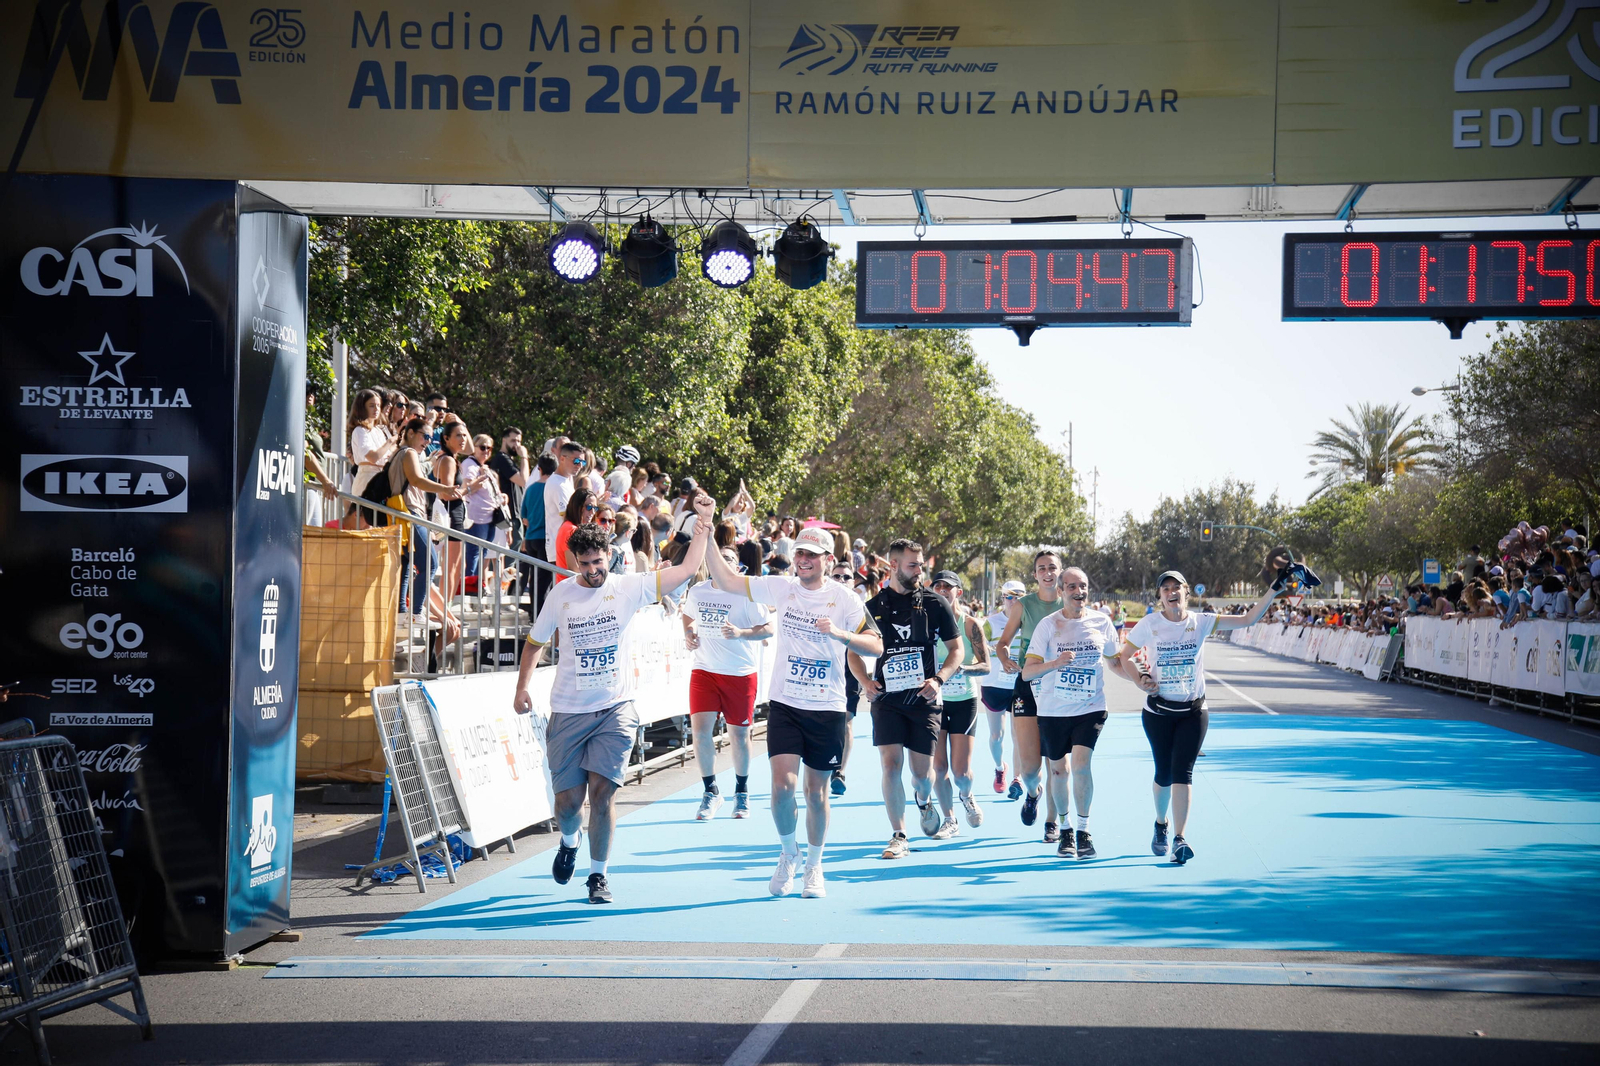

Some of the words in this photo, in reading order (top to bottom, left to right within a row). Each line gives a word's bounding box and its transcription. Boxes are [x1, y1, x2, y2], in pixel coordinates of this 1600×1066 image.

[250, 8, 306, 48] 25
[351, 10, 503, 51] Medio
[529, 14, 740, 54] Maratón
[878, 26, 960, 45] RFEA
[249, 50, 306, 64] EDICIÓN
[870, 47, 951, 61] SERIES
[862, 63, 914, 75] RUTA
[918, 62, 998, 75] RUNNING
[348, 60, 571, 113] Almería
[585, 64, 740, 115] 2024
[775, 86, 900, 115] RAMÓN
[917, 91, 996, 115] RUIZ
[1011, 82, 1180, 114] ANDÚJAR
[20, 246, 154, 297] CASI
[252, 316, 298, 346] COOPERACIÓN
[252, 335, 270, 354] 2005
[20, 386, 191, 408] ESTRELLA
[59, 408, 81, 419] DE
[83, 408, 153, 420] LEVANTE
[44, 471, 169, 495] IKEA
[71, 548, 136, 563] Barceló
[70, 565, 112, 580] Cabo
[117, 565, 137, 580] de
[70, 583, 109, 597] Gata
[697, 602, 732, 610] COSENTINO
[568, 621, 595, 630] Almería
[596, 615, 616, 625] 2024
[701, 613, 726, 624] 5242
[784, 611, 809, 624] Almería
[59, 613, 144, 659] ego
[113, 651, 131, 659] sport
[132, 651, 148, 659] center
[887, 646, 925, 654] CUPRA
[580, 652, 615, 668] 5795
[887, 659, 919, 674] 5388
[790, 663, 827, 679] 5796
[1161, 665, 1194, 678] 5050
[51, 679, 97, 694] SER
[1060, 672, 1092, 686] 5051
[128, 678, 155, 698] 40
[253, 680, 283, 706] ALMERÍA
[51, 715, 65, 725] La
[67, 715, 88, 725] Voz
[90, 715, 104, 725] de
[106, 714, 152, 725] Almería
